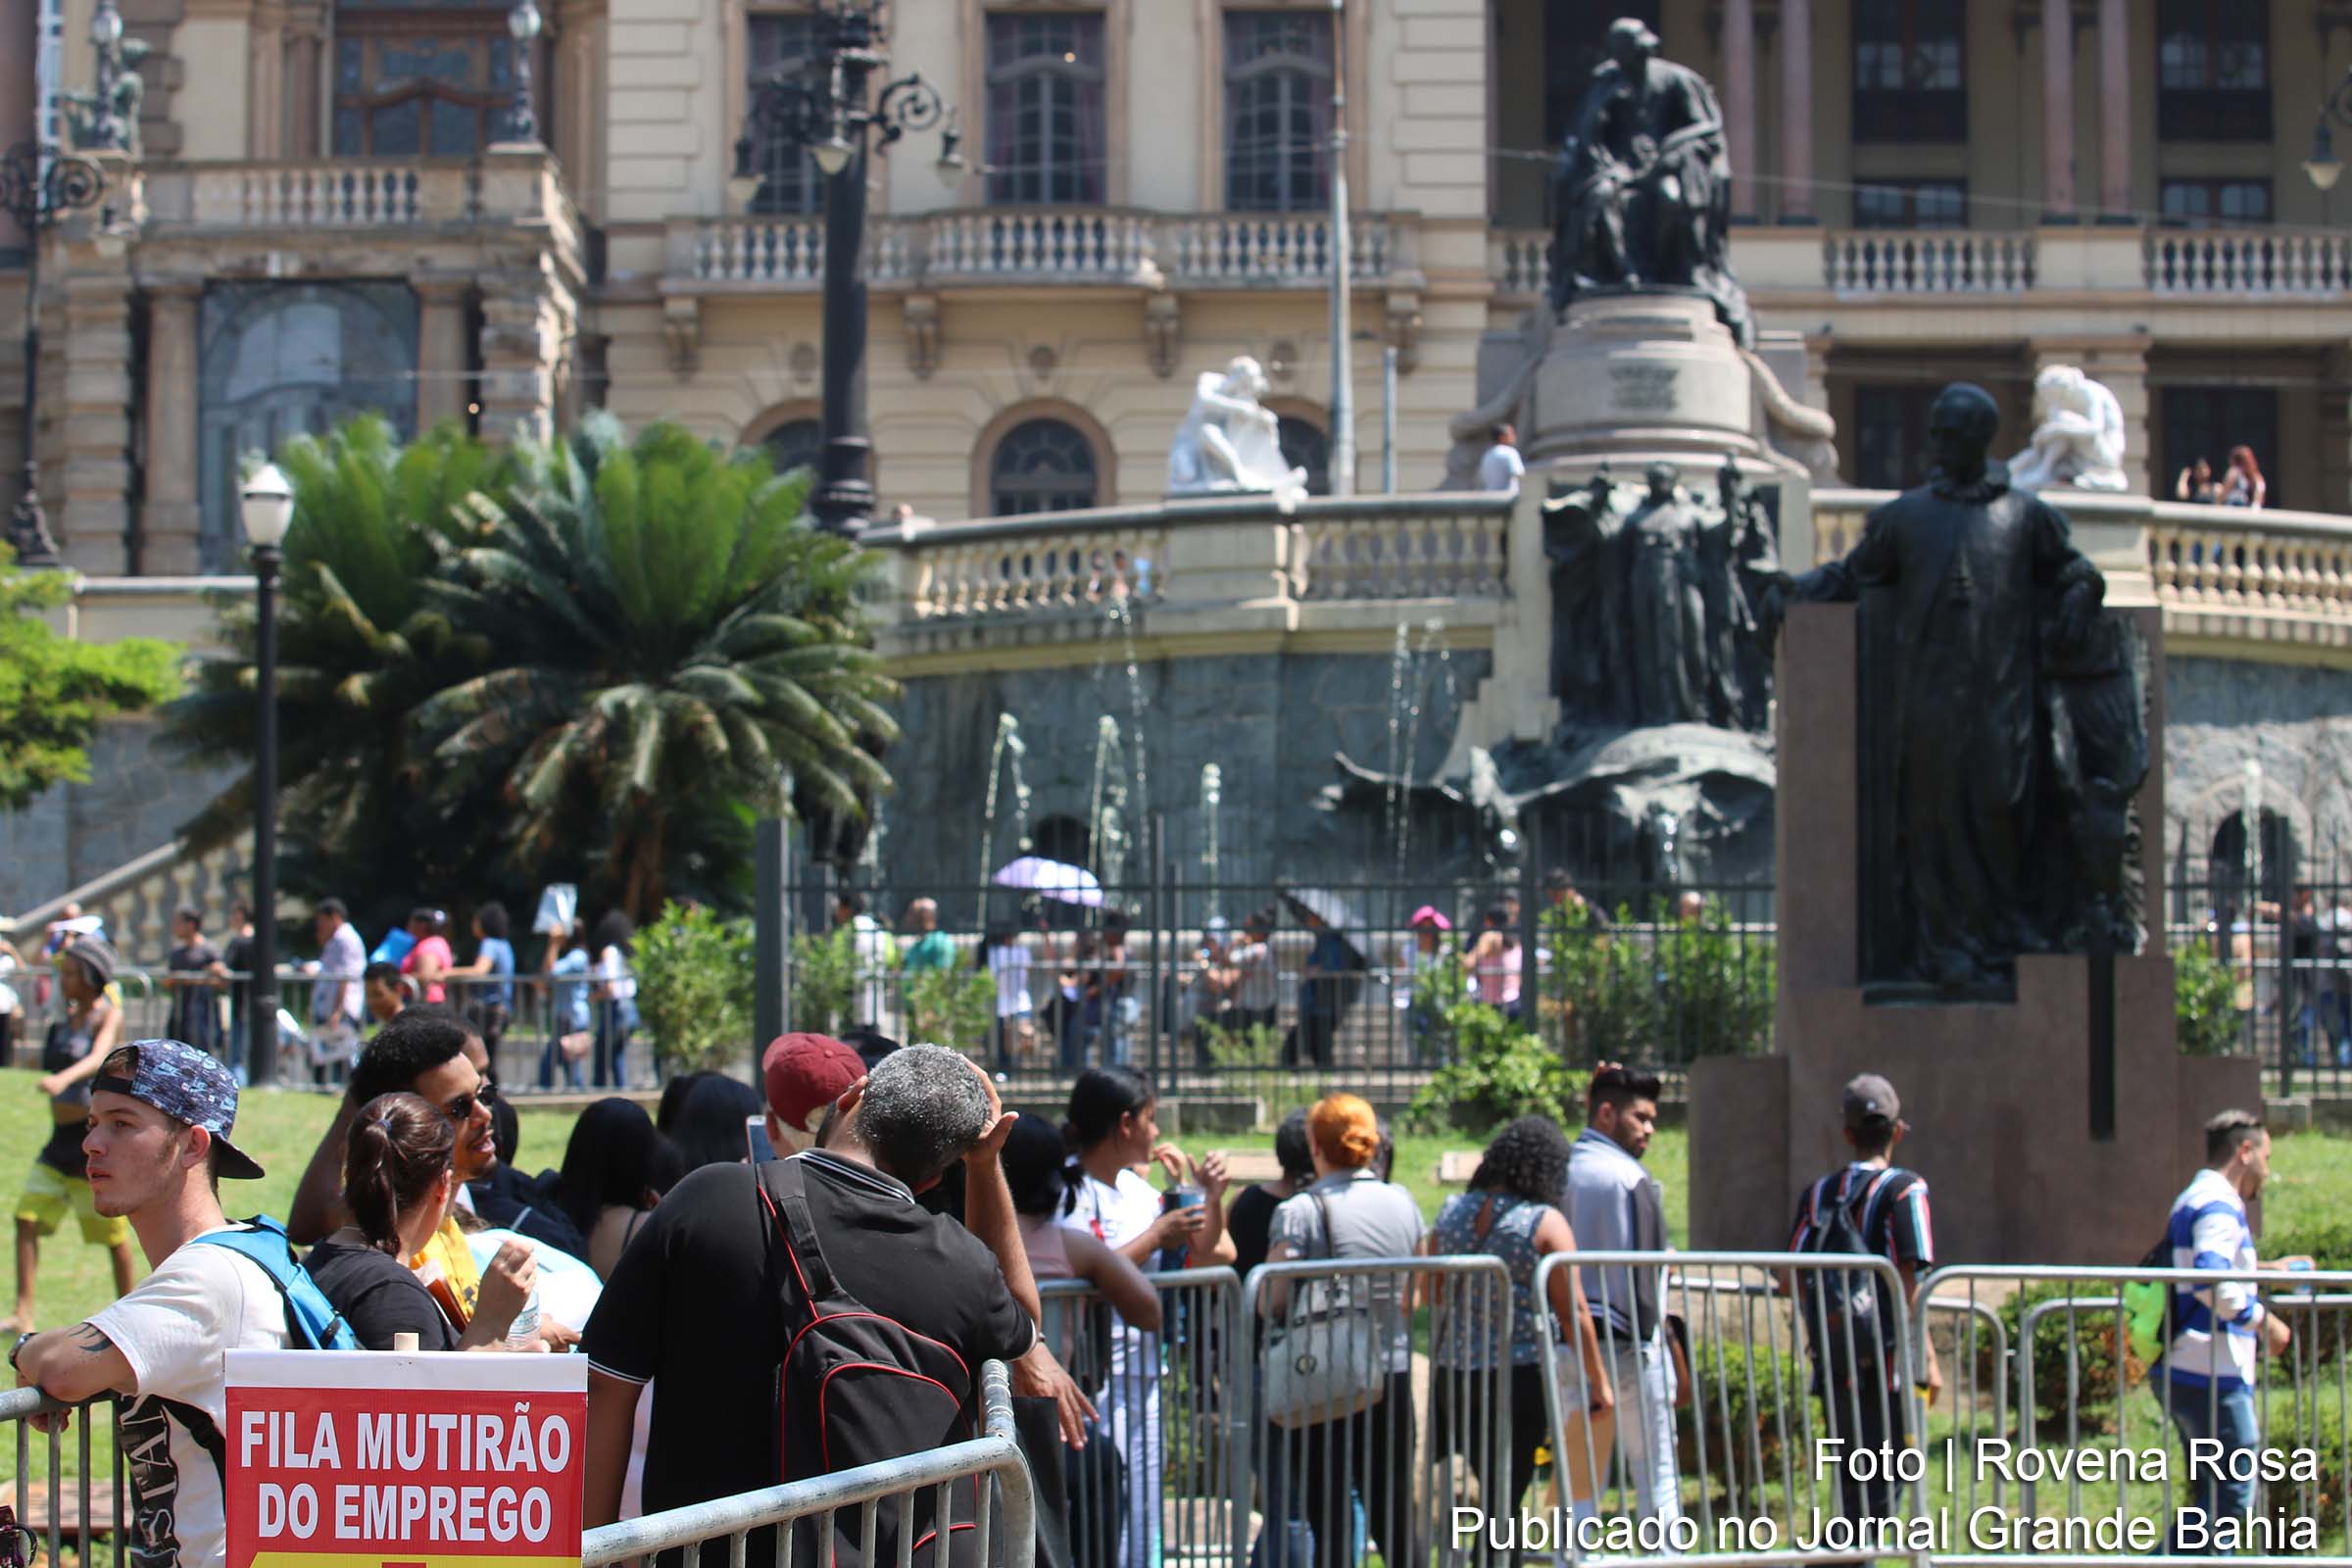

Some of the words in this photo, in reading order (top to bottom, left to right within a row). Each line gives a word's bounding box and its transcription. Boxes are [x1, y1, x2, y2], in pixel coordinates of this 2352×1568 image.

[241, 1410, 342, 1470] FILA
[356, 1400, 571, 1474] MUTIRÃO
[258, 1483, 319, 1540] DO
[334, 1484, 552, 1544] EMPREGO
